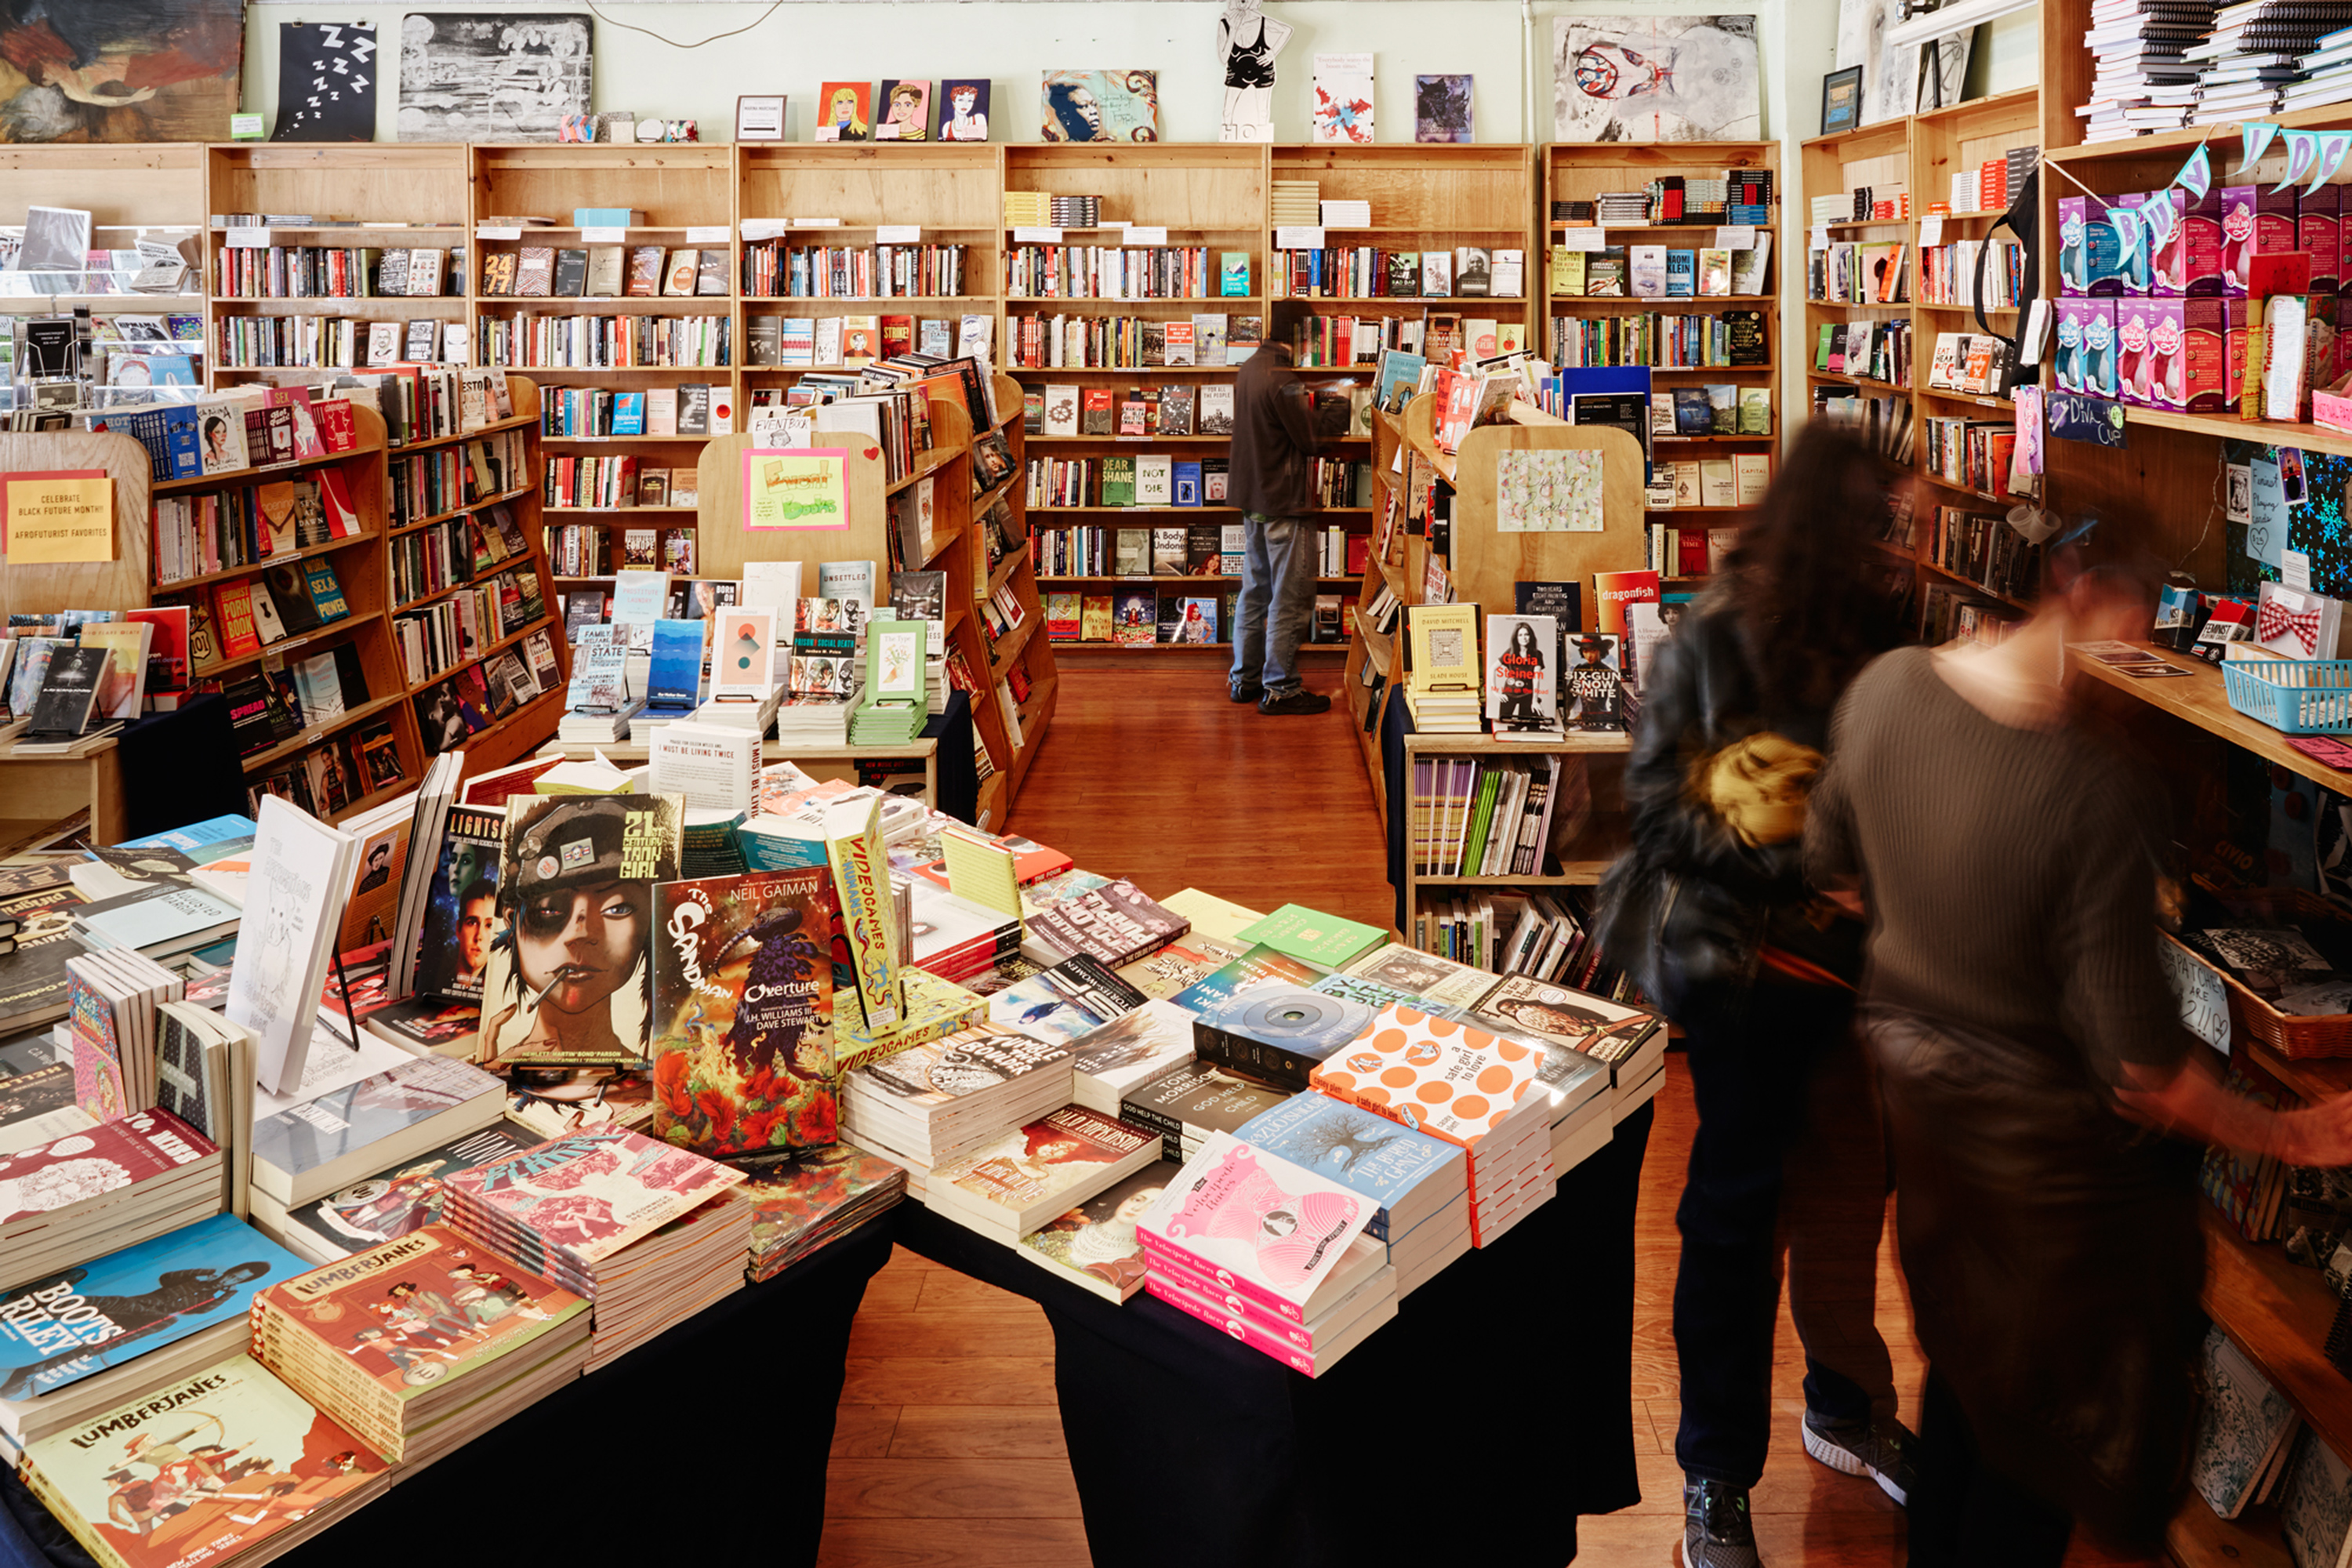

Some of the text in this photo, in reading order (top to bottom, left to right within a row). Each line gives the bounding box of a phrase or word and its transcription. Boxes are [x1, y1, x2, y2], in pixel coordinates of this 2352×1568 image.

[485, 255, 511, 275] 24
[1667, 255, 1690, 264] NAOMI
[1667, 264, 1690, 274] KLEIN
[884, 326, 909, 339] STRIKE!
[1194, 326, 1225, 336] THIS
[2263, 321, 2274, 374] Trisonic
[274, 392, 290, 405] SEX
[270, 409, 288, 421] Hot
[1103, 459, 1129, 471] DEAR
[1142, 469, 1167, 477] NOT
[1102, 471, 1134, 484] SHANE
[1515, 454, 1582, 498] Spring
[1145, 484, 1163, 493] DIE
[41, 494, 81, 504] CELEBRATE
[261, 498, 294, 514] opening
[18, 506, 41, 516] BLACK
[43, 506, 71, 516] FUTURE
[273, 510, 285, 522] up
[304, 508, 314, 517] AT
[299, 517, 324, 528] DAWN
[15, 528, 107, 539] AFROFUTURIST FAVORITES
[626, 541, 655, 550] EUROPE
[1153, 541, 1185, 550] Undone
[823, 573, 867, 583] UNSETTLED
[221, 585, 249, 601] FEMINIST
[1602, 586, 1654, 601] dragonfish
[223, 604, 252, 618] PORN
[318, 600, 348, 617] POWER
[227, 618, 254, 633] BOOK
[2205, 623, 2232, 635] FEMINIST
[794, 637, 813, 648] PRISON
[818, 637, 837, 648] SOCIAL
[837, 638, 855, 649] DEATH
[1501, 653, 1538, 666] Gloria
[1496, 666, 1544, 681] Steinem
[1564, 670, 1622, 681] SIX-GUN
[1572, 679, 1614, 690] SNOW
[230, 699, 266, 720] SPREAD
[663, 746, 680, 755] MUST
[681, 746, 690, 756] BE
[691, 747, 713, 758] LIVING
[714, 749, 735, 760] TWICE
[622, 836, 663, 848] CENTURY
[622, 847, 662, 862] TANK
[619, 862, 660, 880] GIRL
[731, 880, 818, 902] NEIL GAIMAN
[841, 858, 863, 918] HUMANS
[850, 837, 885, 951] VIDEOGAMES
[159, 894, 198, 917] MARGIN
[175, 891, 223, 917] ADJUSTED
[1058, 898, 1126, 953] COLOR
[1044, 909, 1116, 961] ALICE WALKER
[2176, 953, 2227, 1003] PATCHES
[744, 980, 821, 1004] Overture
[745, 1007, 813, 1024] J.H. WILLIAMS III
[756, 1014, 821, 1032] DAVE STEWART
[1296, 1022, 1322, 1037] DAVID
[1322, 1014, 1367, 1042] MITCHELL
[958, 1040, 1035, 1076] BOULDER
[985, 1034, 1069, 1065] TUMBLE
[1444, 1049, 1474, 1082] safe girl
[1460, 1053, 1486, 1082] to love
[1153, 1069, 1219, 1105] MORRISON
[1159, 1071, 1194, 1091] TONI
[1312, 1075, 1343, 1094] casey plett
[1192, 1083, 1247, 1112] GOD HELP
[1225, 1094, 1258, 1114] CHILD
[122, 1111, 156, 1134] YO,
[1123, 1103, 1181, 1131] GOD HELP THE CHILD
[1247, 1094, 1333, 1146] KAZUO ISHIGURO
[1047, 1108, 1149, 1152] NALO HOPKINSON
[1383, 1152, 1424, 1181] GIANT
[1184, 1160, 1237, 1219] Velocipede
[1206, 1178, 1236, 1212] Races
[1140, 1232, 1215, 1276] The Velocipede Races
[35, 1280, 126, 1349] BOOTS
[0, 1294, 84, 1356] RILEY
[70, 1372, 227, 1450] LUMBERJANES
[165, 1533, 235, 1568] NEW YORK TIMES
